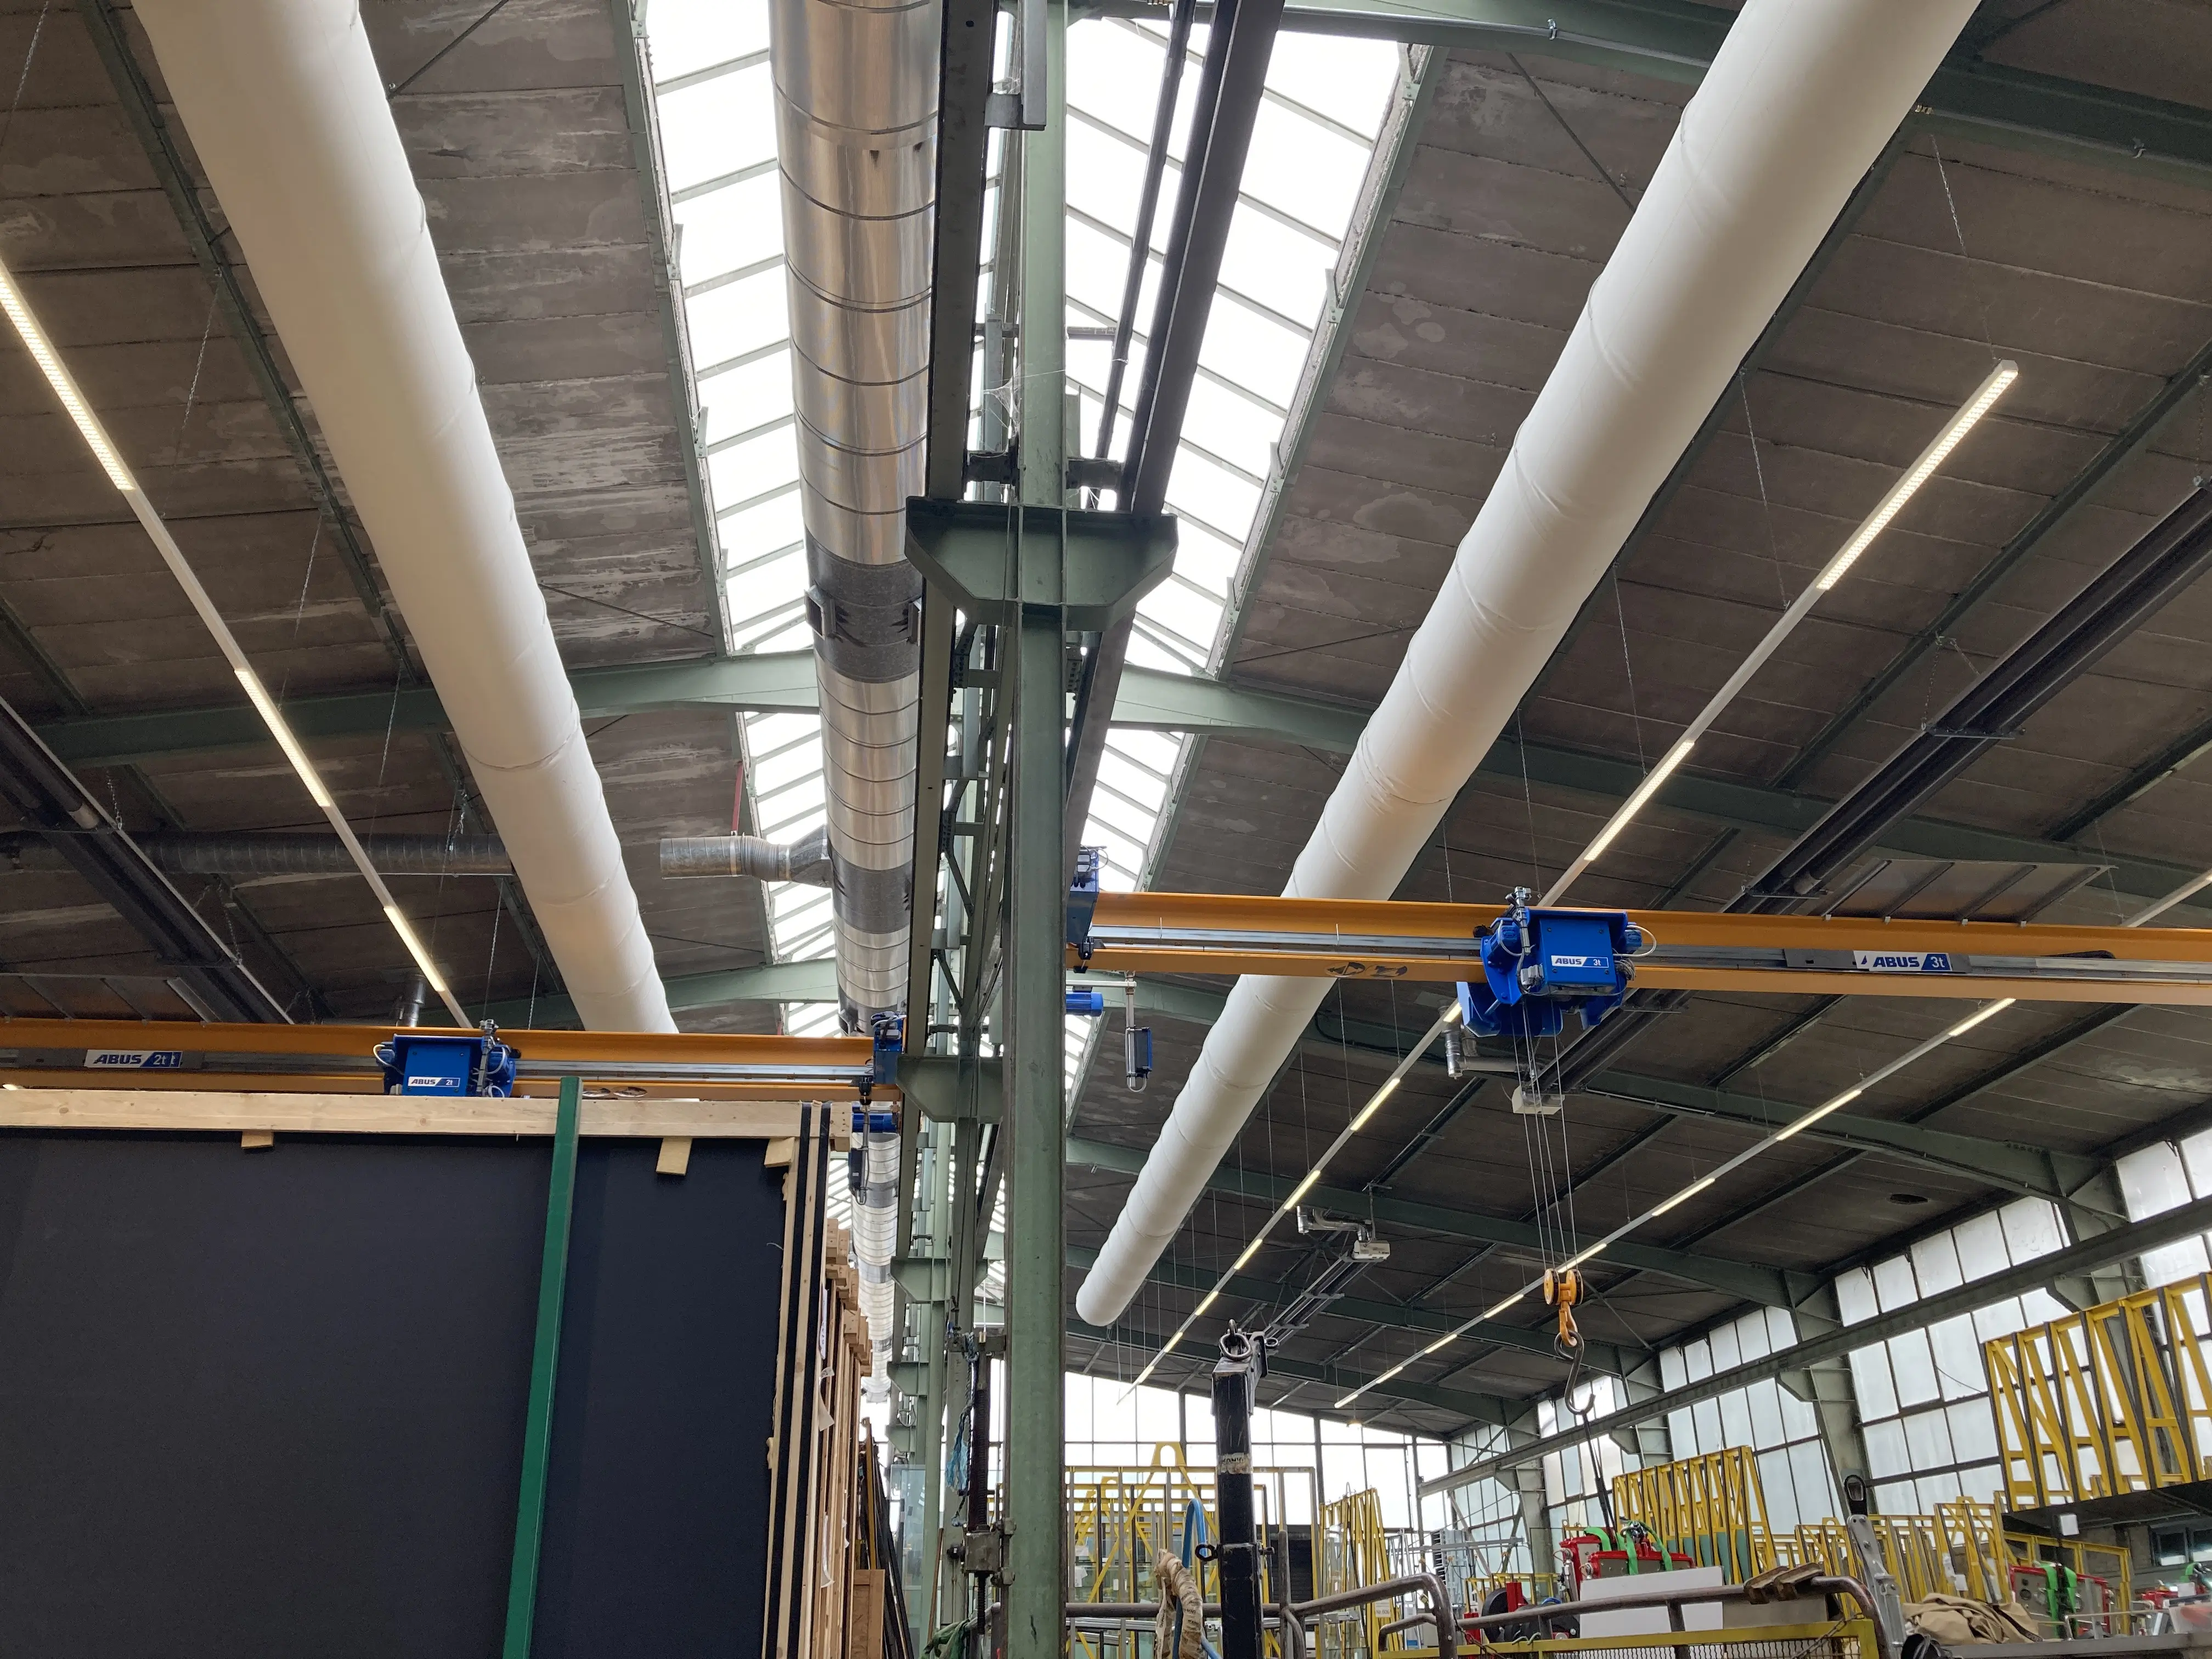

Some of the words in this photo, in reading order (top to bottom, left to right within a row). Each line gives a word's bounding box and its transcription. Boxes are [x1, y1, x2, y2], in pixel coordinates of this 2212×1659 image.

[1872, 956, 1920, 968] ABUS
[1930, 956, 1945, 968] 3t
[93, 1054, 143, 1064] ABUS
[153, 1054, 167, 1065] 2t
